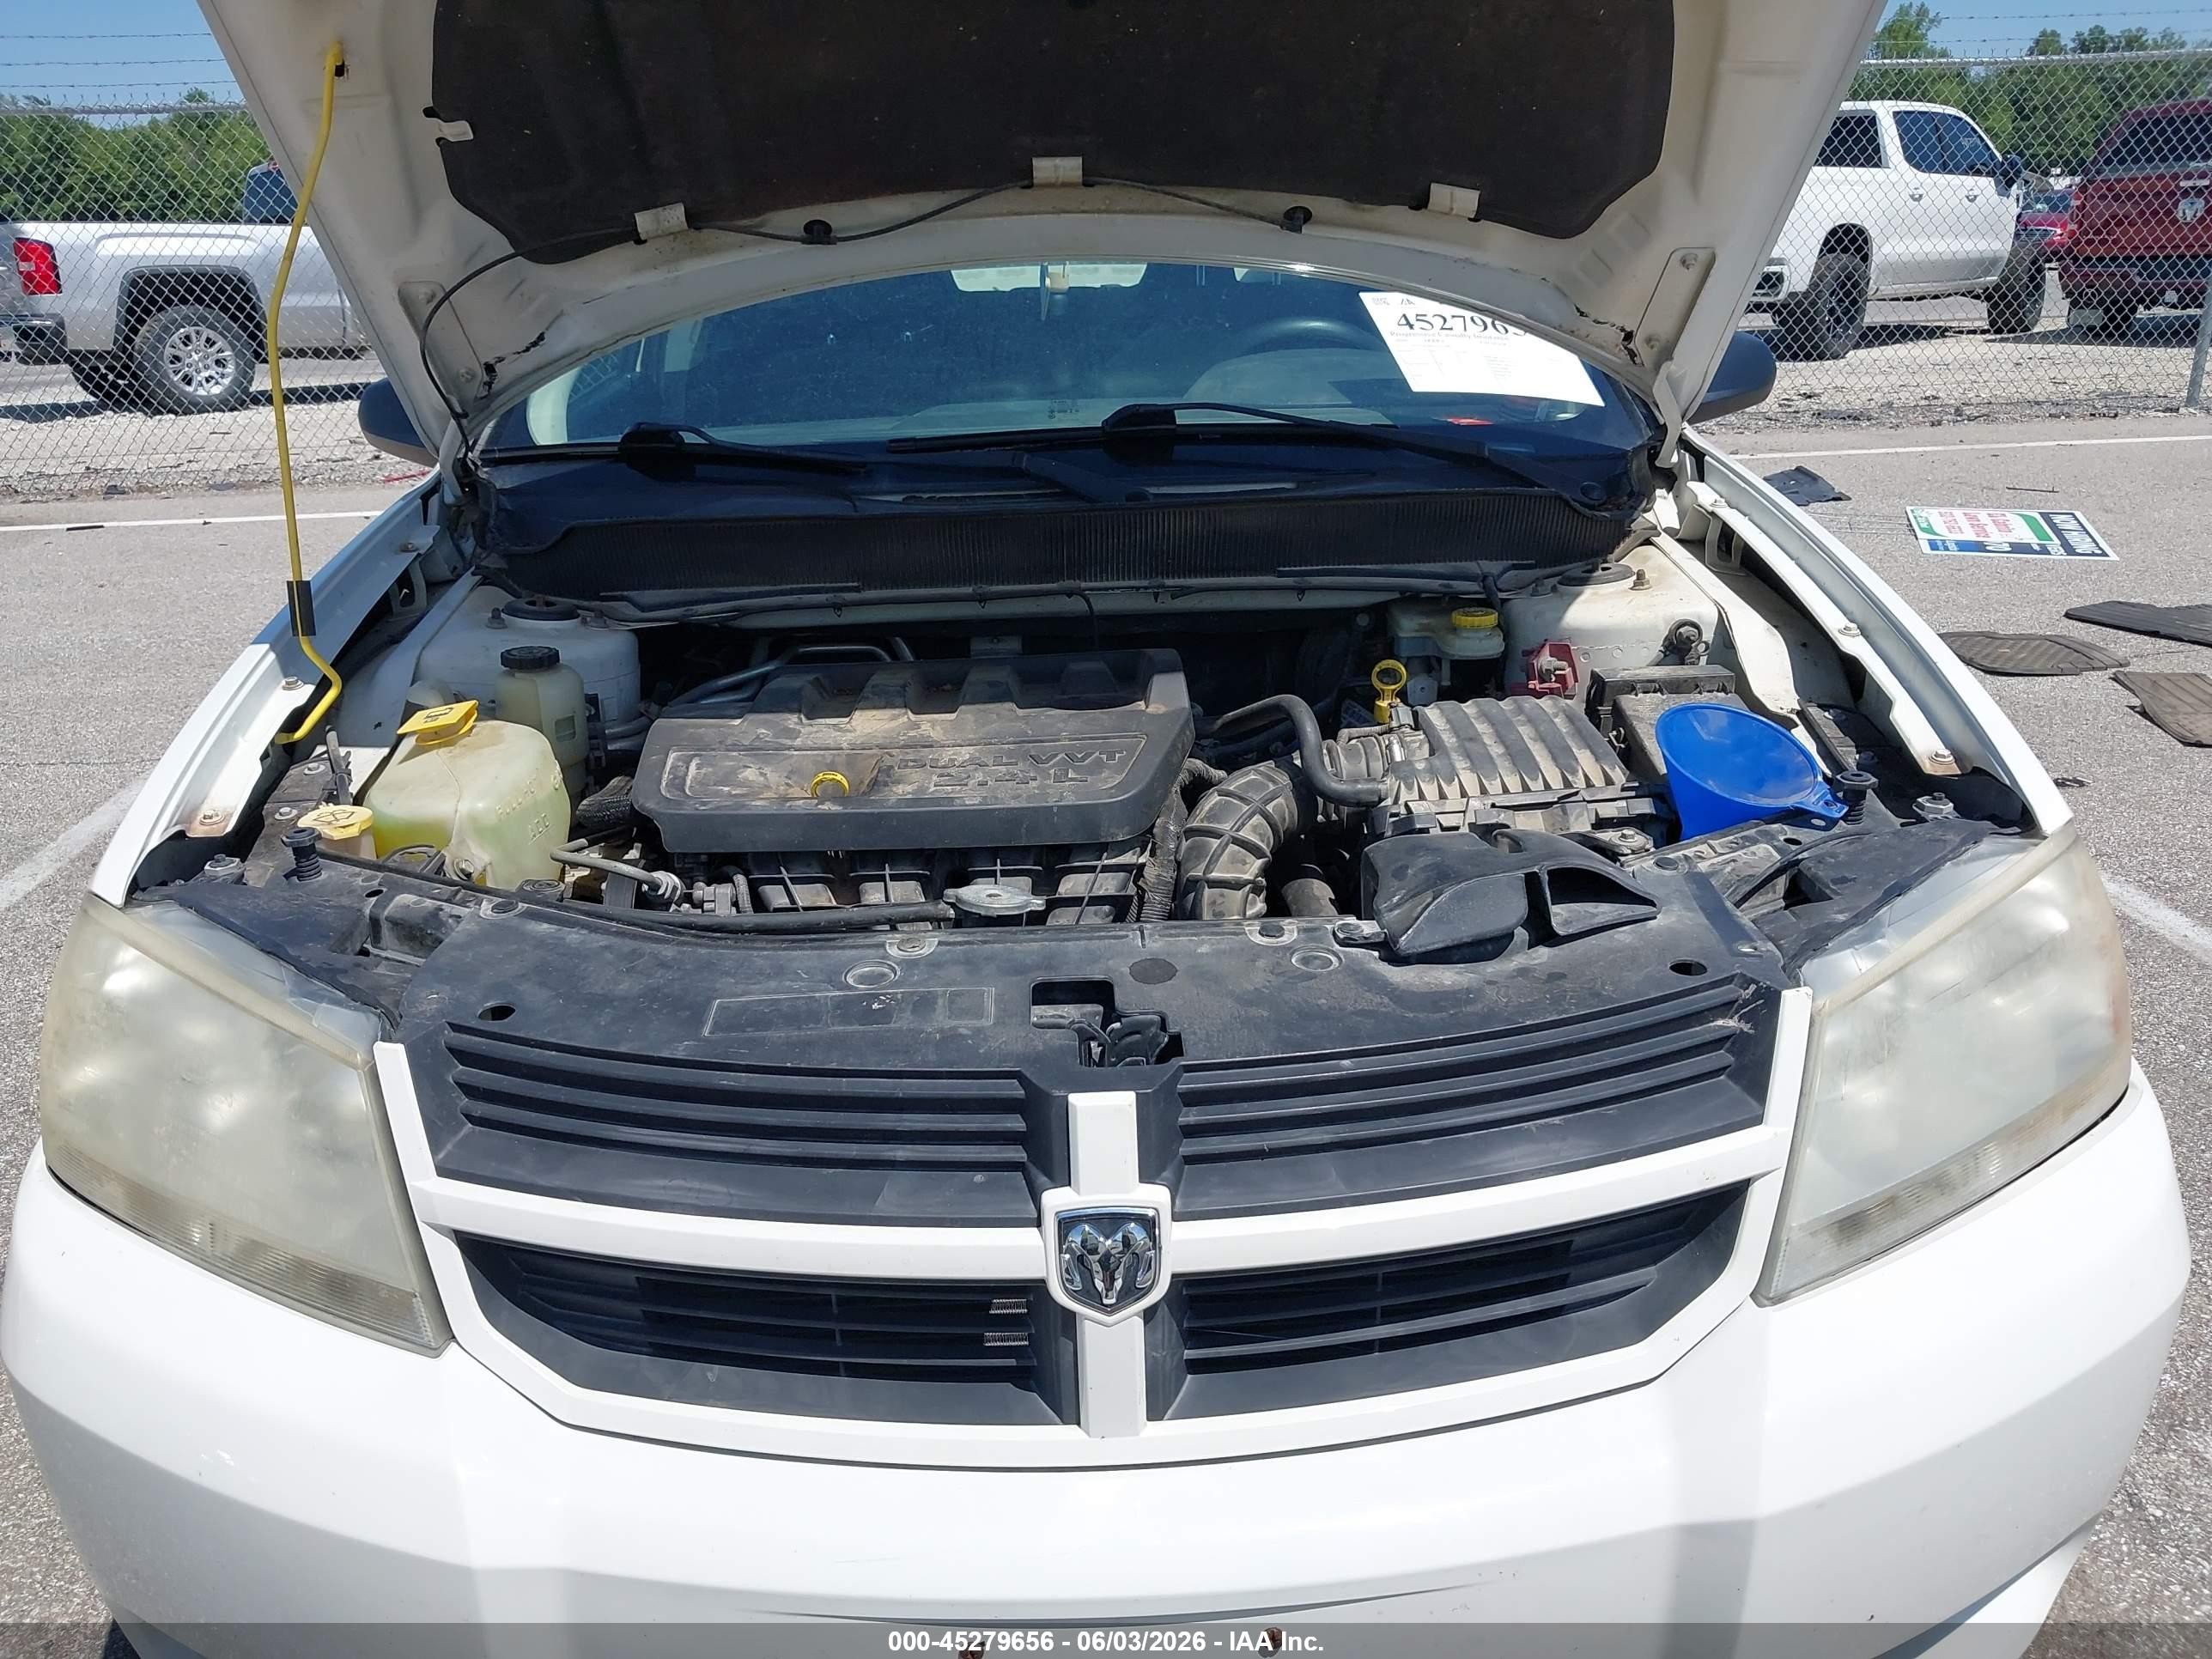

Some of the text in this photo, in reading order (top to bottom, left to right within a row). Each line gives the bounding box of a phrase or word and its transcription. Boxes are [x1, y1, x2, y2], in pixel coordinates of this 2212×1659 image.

[2049, 514, 2103, 554] NOW HIRING
[897, 750, 1127, 770] DUAL VVT
